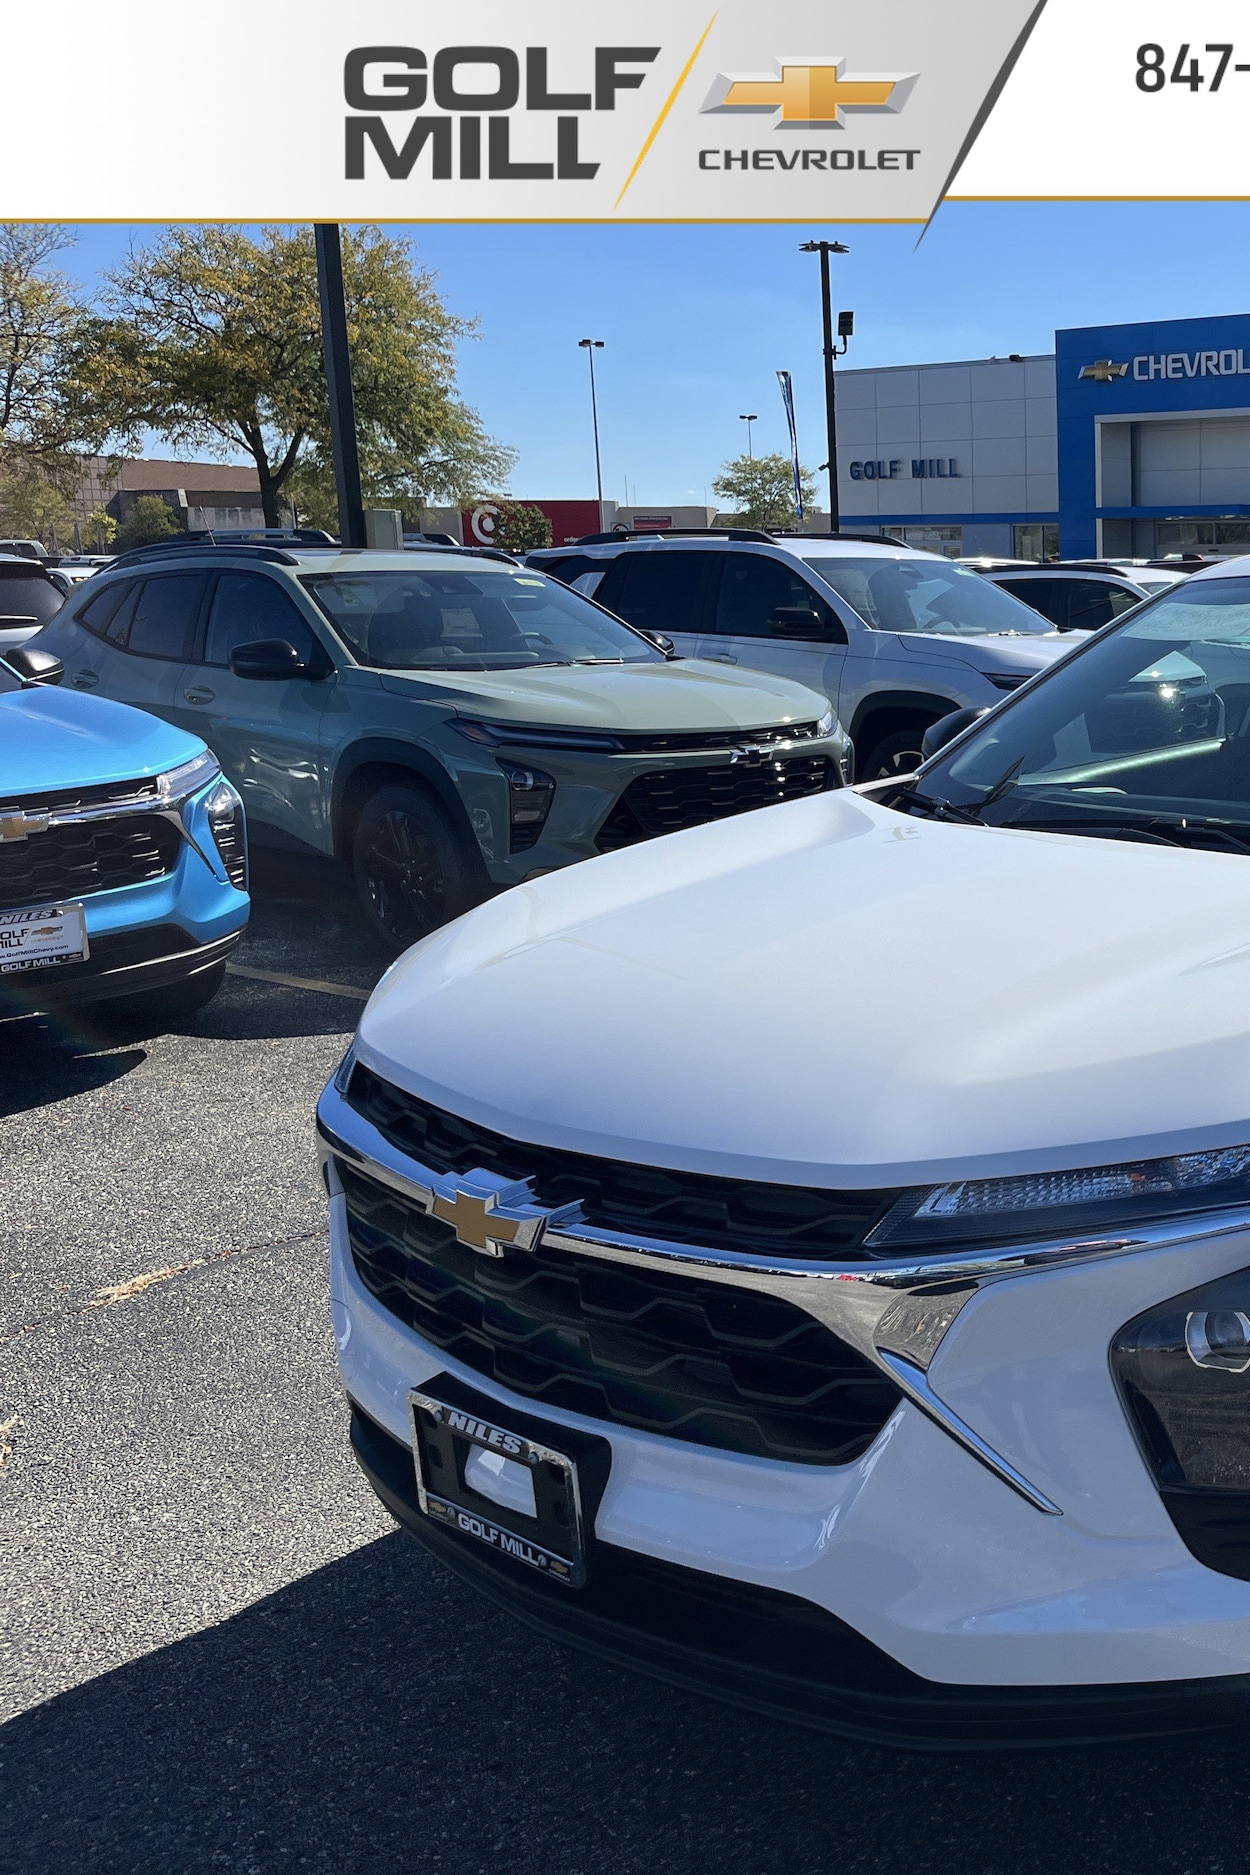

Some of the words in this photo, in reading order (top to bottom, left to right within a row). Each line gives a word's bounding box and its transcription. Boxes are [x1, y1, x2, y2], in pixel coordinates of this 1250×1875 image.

[849, 460, 901, 480] GOLF
[911, 459, 962, 479] MILL
[0, 910, 53, 924] NILES
[0, 928, 29, 940] OLF
[1, 960, 32, 972] GOLF
[33, 956, 61, 967] MILL
[448, 1412, 522, 1454] NILES
[458, 1513, 499, 1543] GOLF
[500, 1534, 540, 1566] MILL
